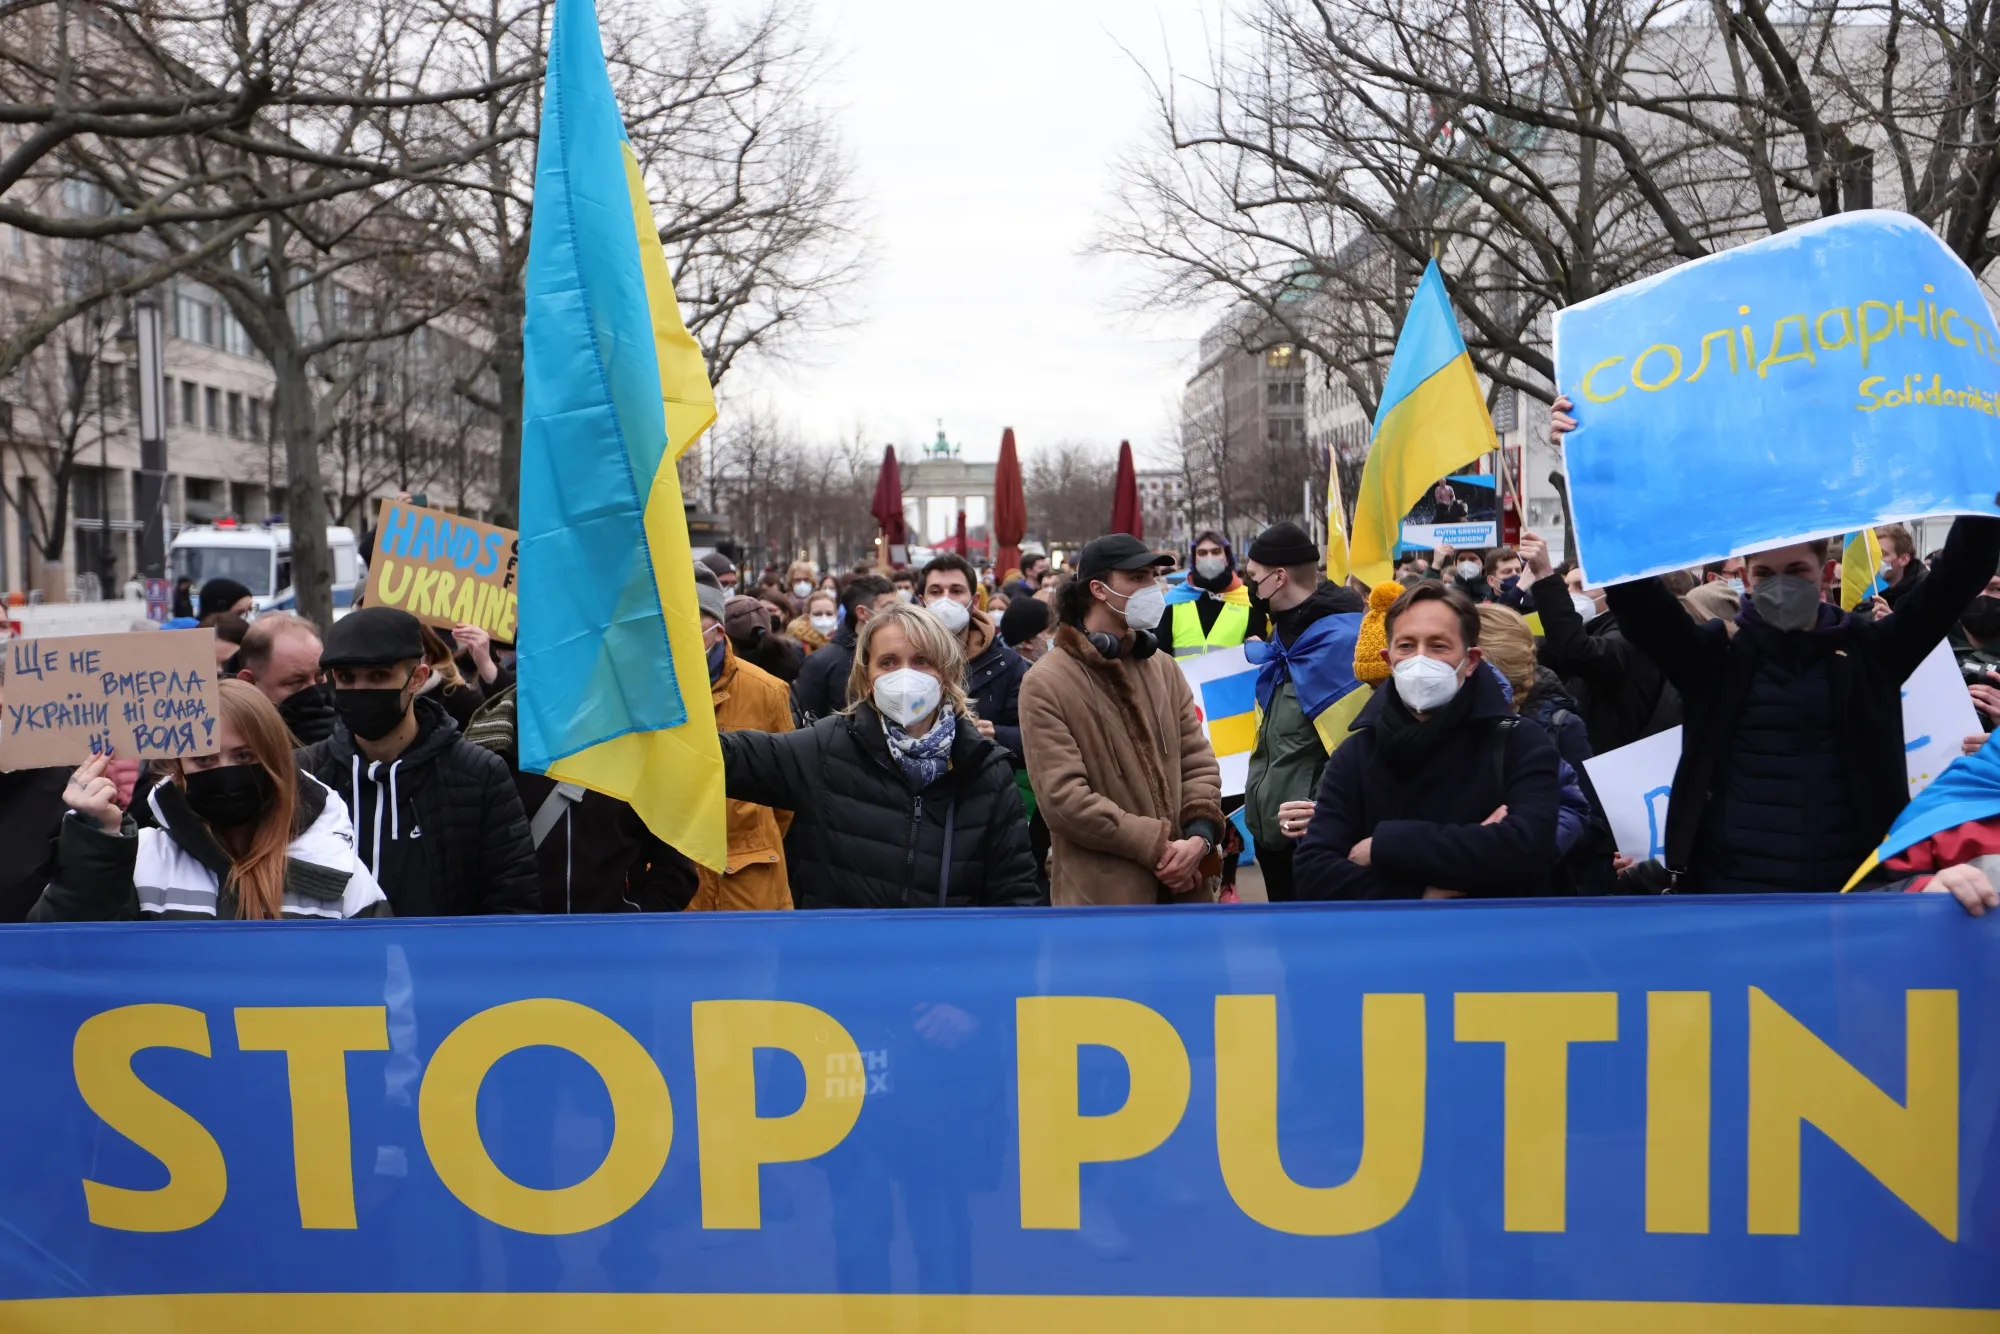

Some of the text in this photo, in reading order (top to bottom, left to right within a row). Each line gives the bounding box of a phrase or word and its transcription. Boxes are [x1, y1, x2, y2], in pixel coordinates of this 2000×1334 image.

[381, 506, 503, 576] HANDS
[379, 560, 518, 641] UKRAINE
[70, 650, 101, 674] НЕ
[100, 668, 206, 698] ВМЕРЛА
[8, 693, 109, 735] УКРАЇНИ
[826, 1049, 888, 1074] ПТН
[825, 1071, 889, 1098] ПНХ
[72, 986, 1959, 1243] STOP PUTIN
